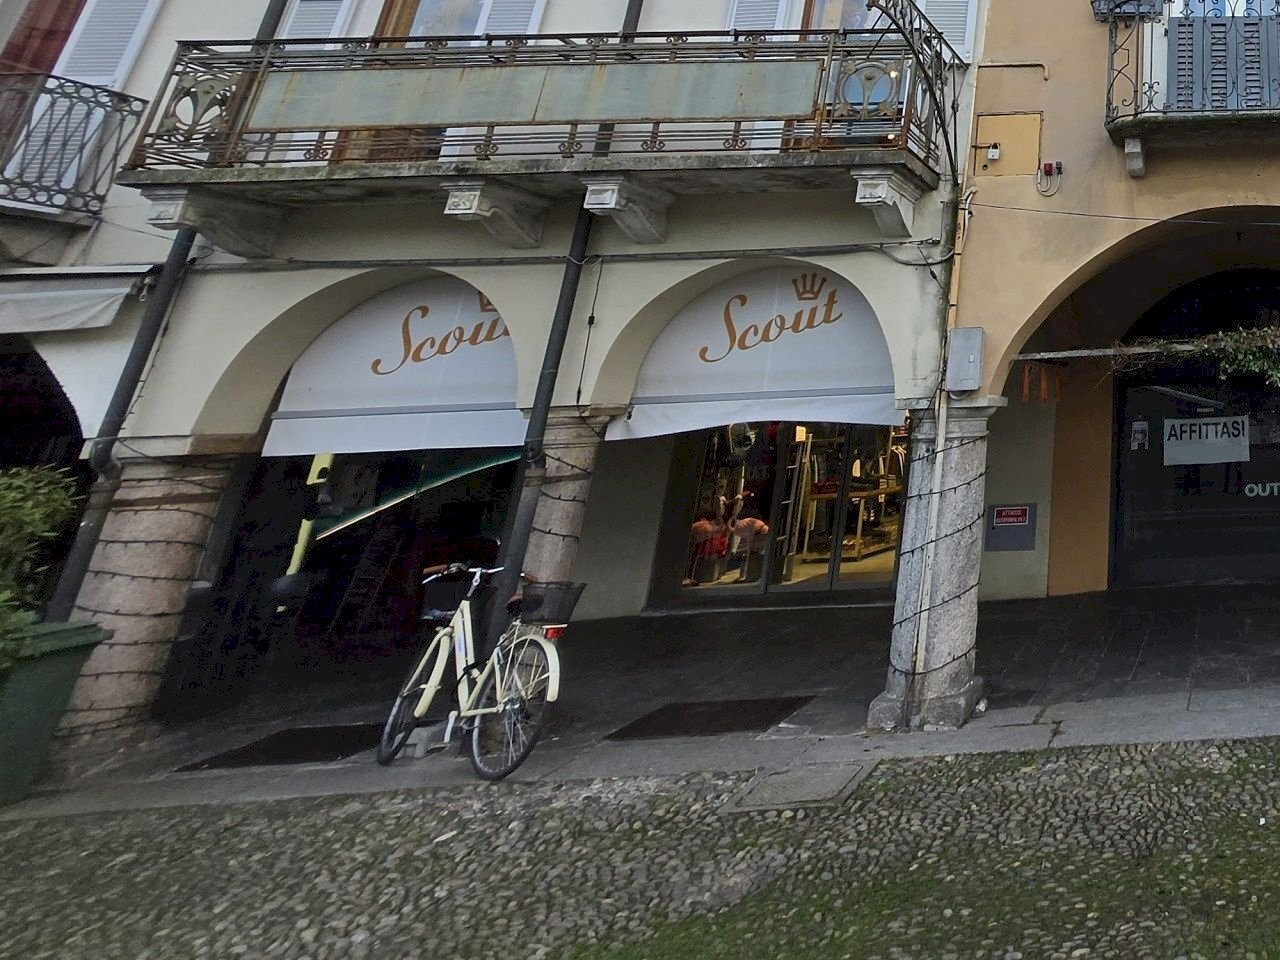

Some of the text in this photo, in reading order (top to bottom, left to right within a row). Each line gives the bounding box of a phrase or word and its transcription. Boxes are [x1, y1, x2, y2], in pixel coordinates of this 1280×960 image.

[370, 305, 510, 375] Scou
[698, 288, 843, 363] Scout
[1166, 420, 1245, 441] AFFITTASI
